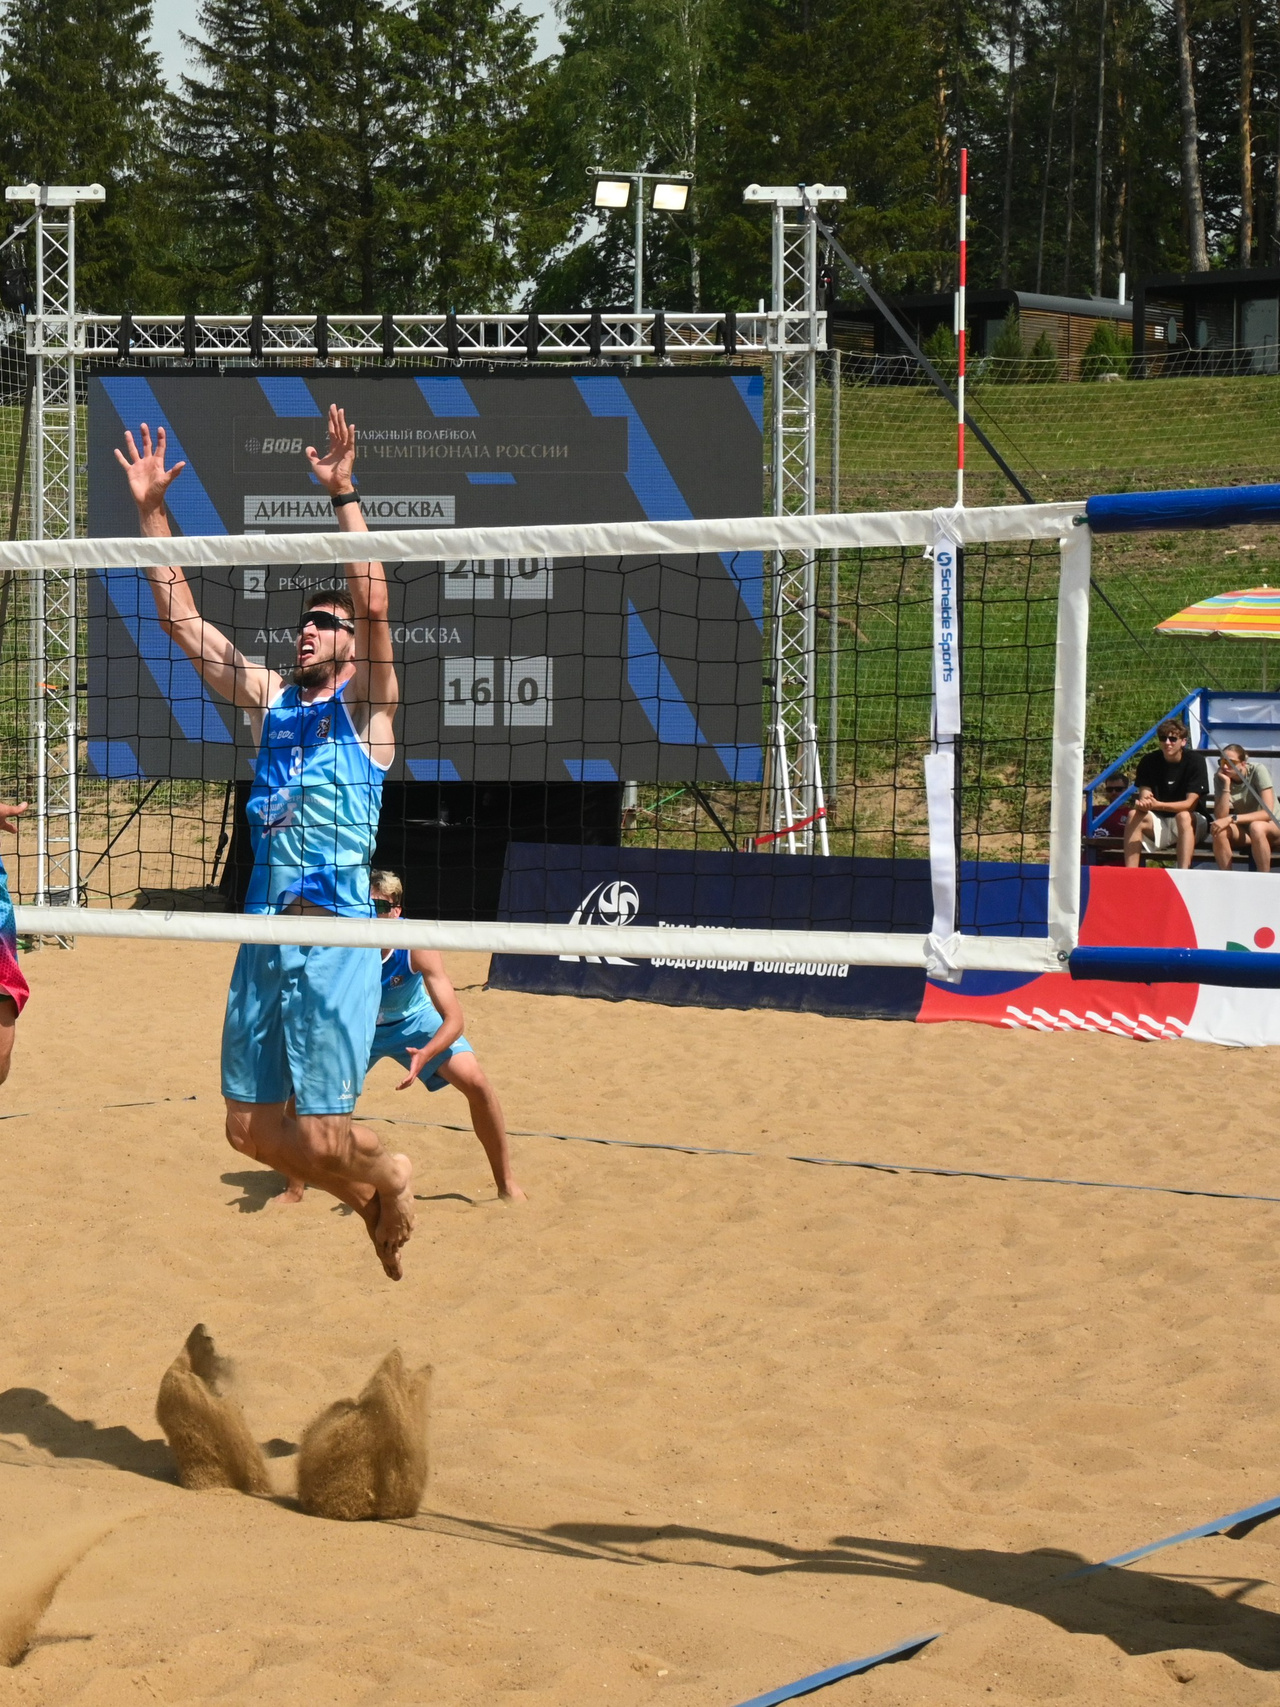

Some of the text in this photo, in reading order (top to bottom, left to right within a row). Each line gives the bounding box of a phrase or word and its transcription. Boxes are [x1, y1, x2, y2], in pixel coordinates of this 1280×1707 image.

[354, 428, 477, 440] ПЛЯЖНЫЙ ВОЛЕЙБОЛ
[261, 437, 303, 454] ВФВ
[374, 444, 491, 458] ЧЕМПИОНАТА
[496, 443, 569, 458] РОССИИ
[254, 501, 338, 520] ДИНАМ
[249, 576, 260, 593] 2
[937, 567, 954, 683] Schelde Sports
[448, 677, 492, 706] 16
[517, 677, 539, 706] 0
